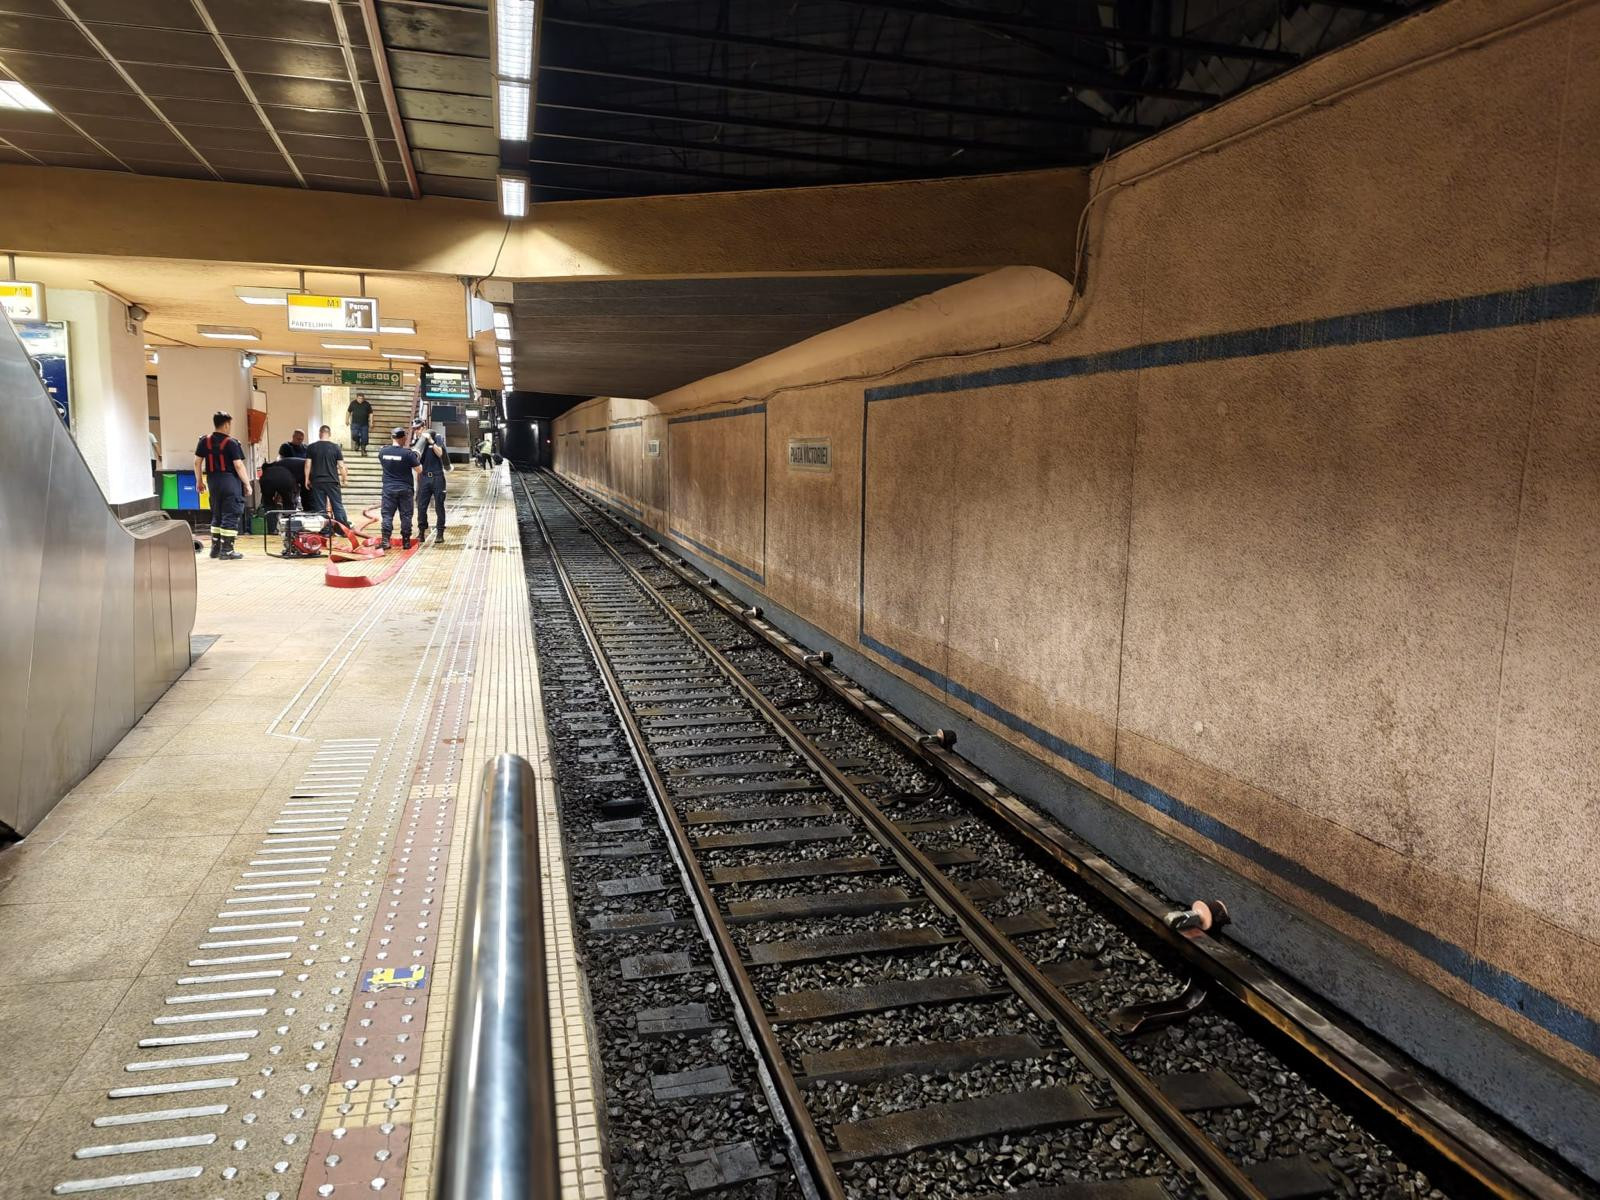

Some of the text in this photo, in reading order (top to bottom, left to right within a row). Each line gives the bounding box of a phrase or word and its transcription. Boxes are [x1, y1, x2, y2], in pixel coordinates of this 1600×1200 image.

[327, 299, 340, 307] M1
[349, 303, 369, 311] Peron
[291, 320, 333, 328] PANTELIMON
